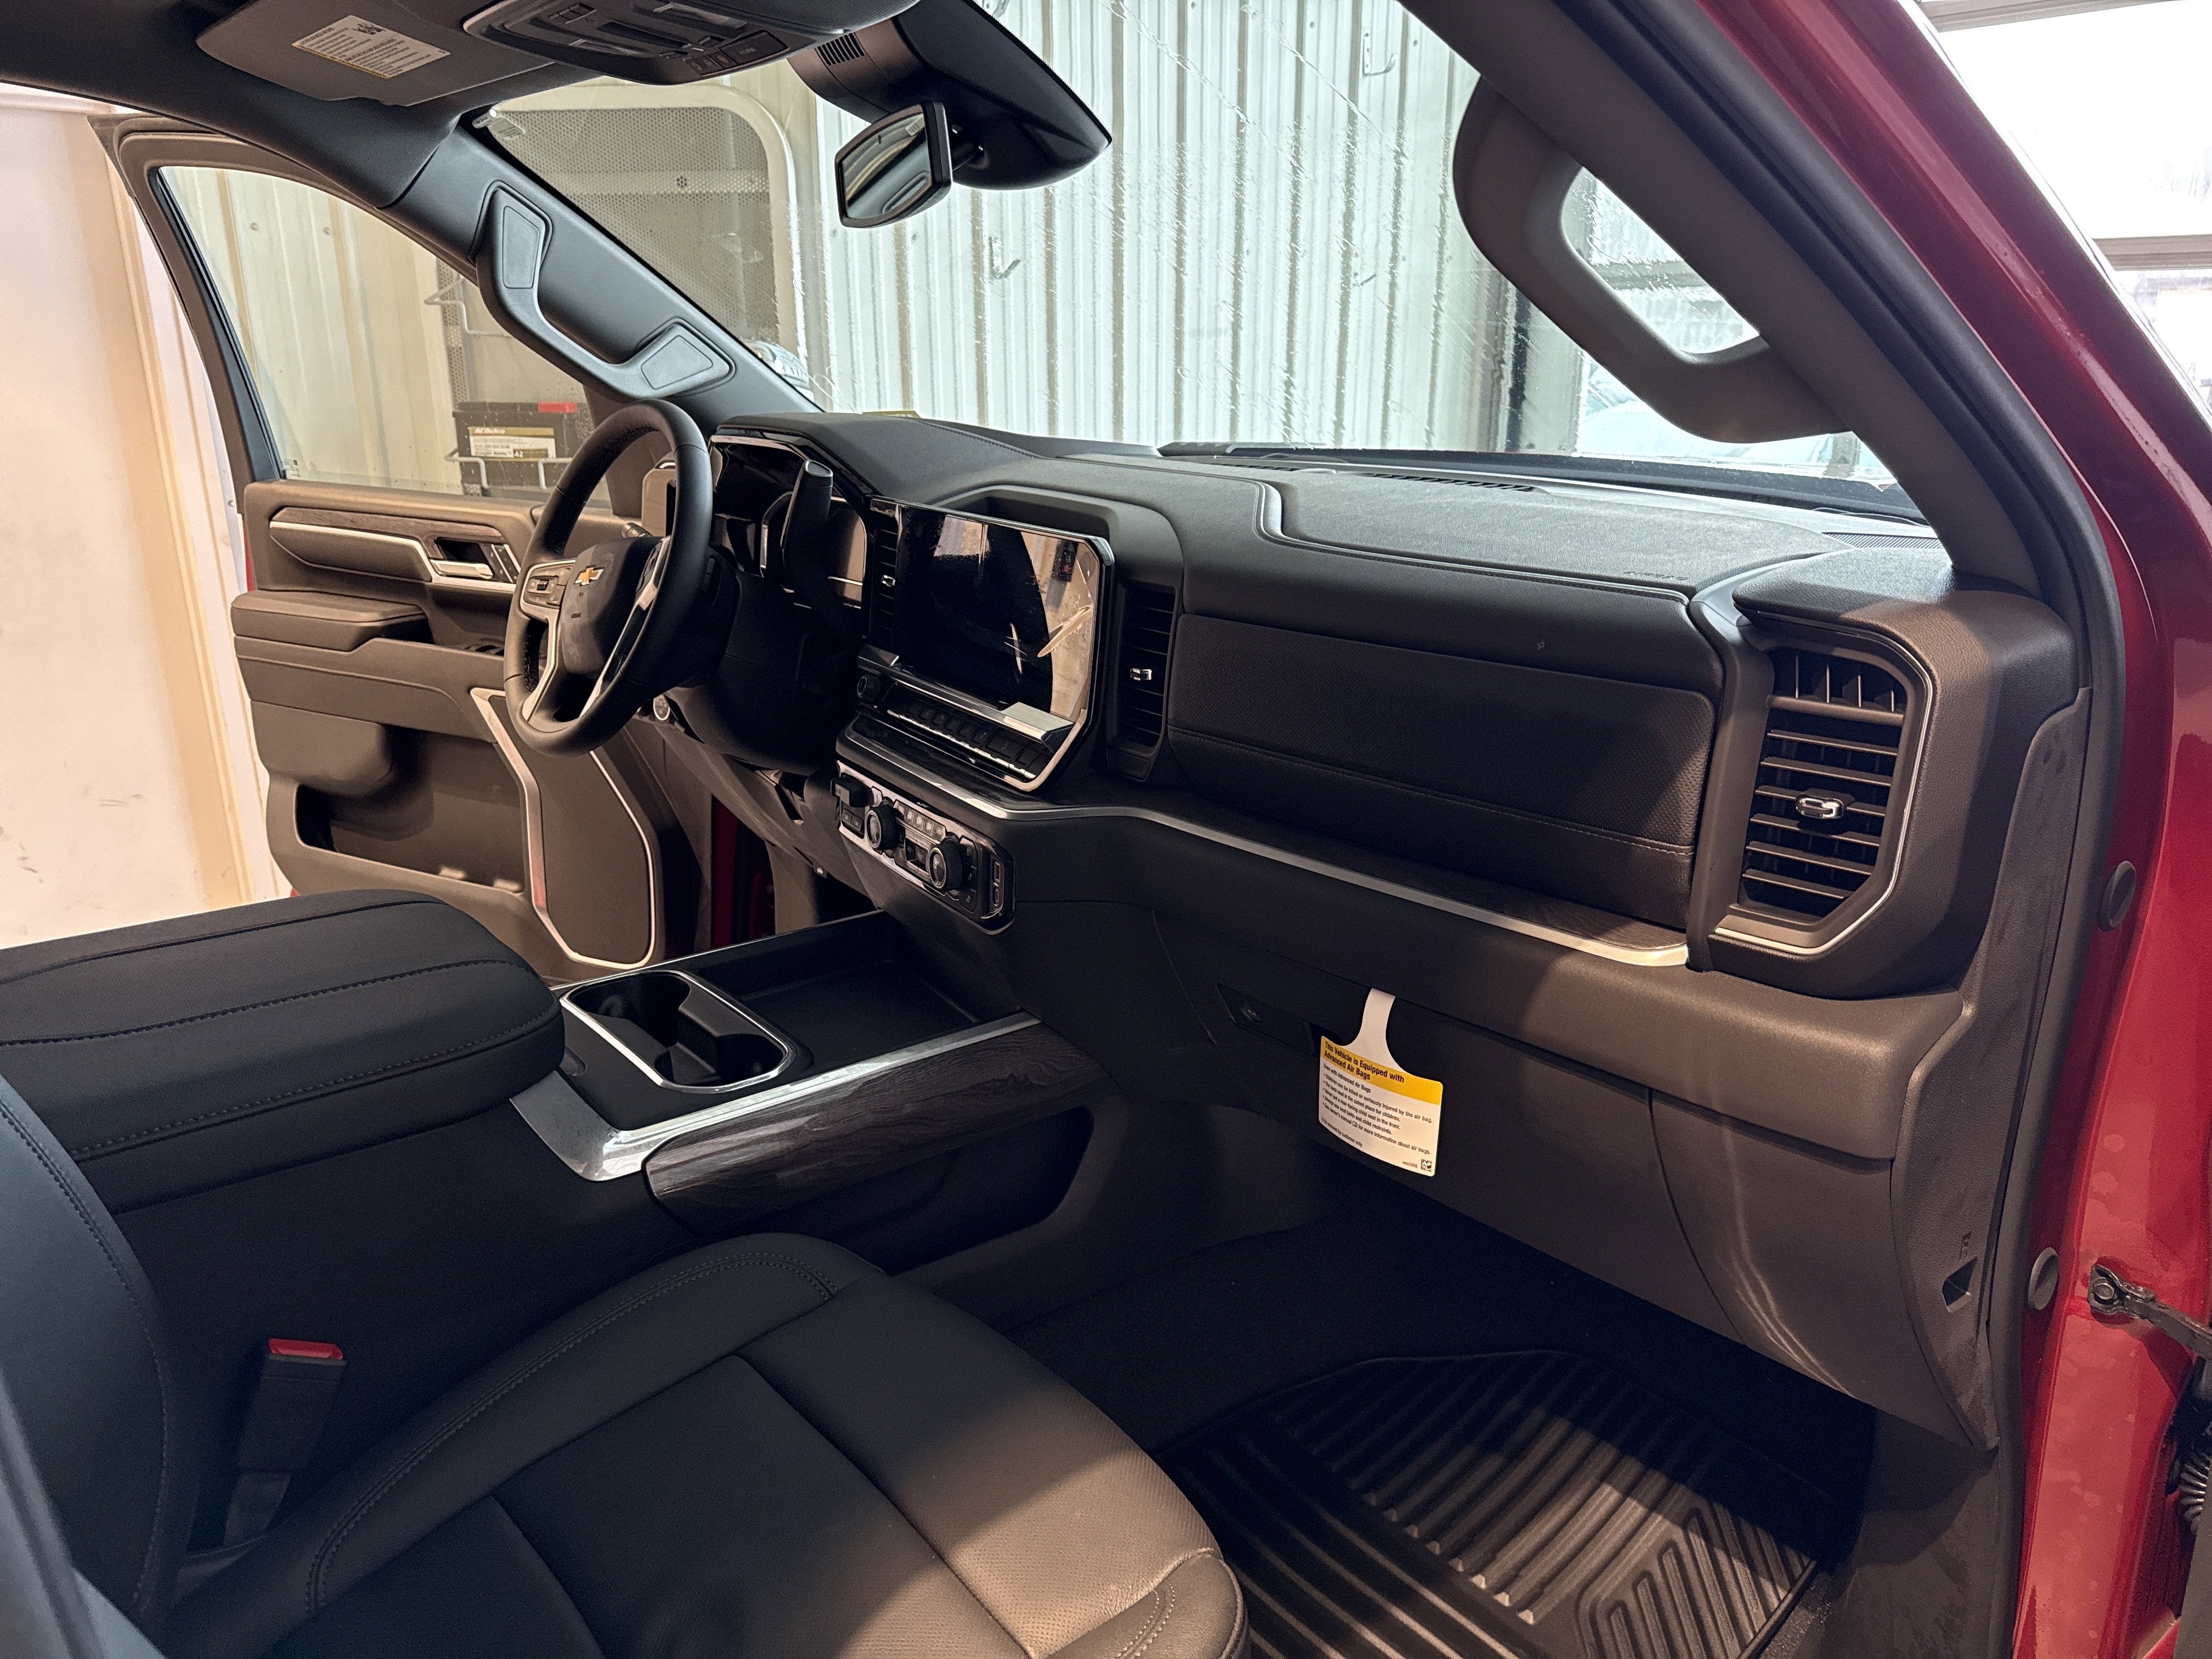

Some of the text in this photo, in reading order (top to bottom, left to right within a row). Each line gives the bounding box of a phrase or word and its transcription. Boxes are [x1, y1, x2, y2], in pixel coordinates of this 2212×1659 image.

[1324, 1050, 1370, 1080] Advanced Air Bags
[1325, 1041, 1404, 1084] This Vehicle is Equipped with
[1338, 1073, 1355, 1085] Advanced
[1361, 1085, 1371, 1093] Bags
